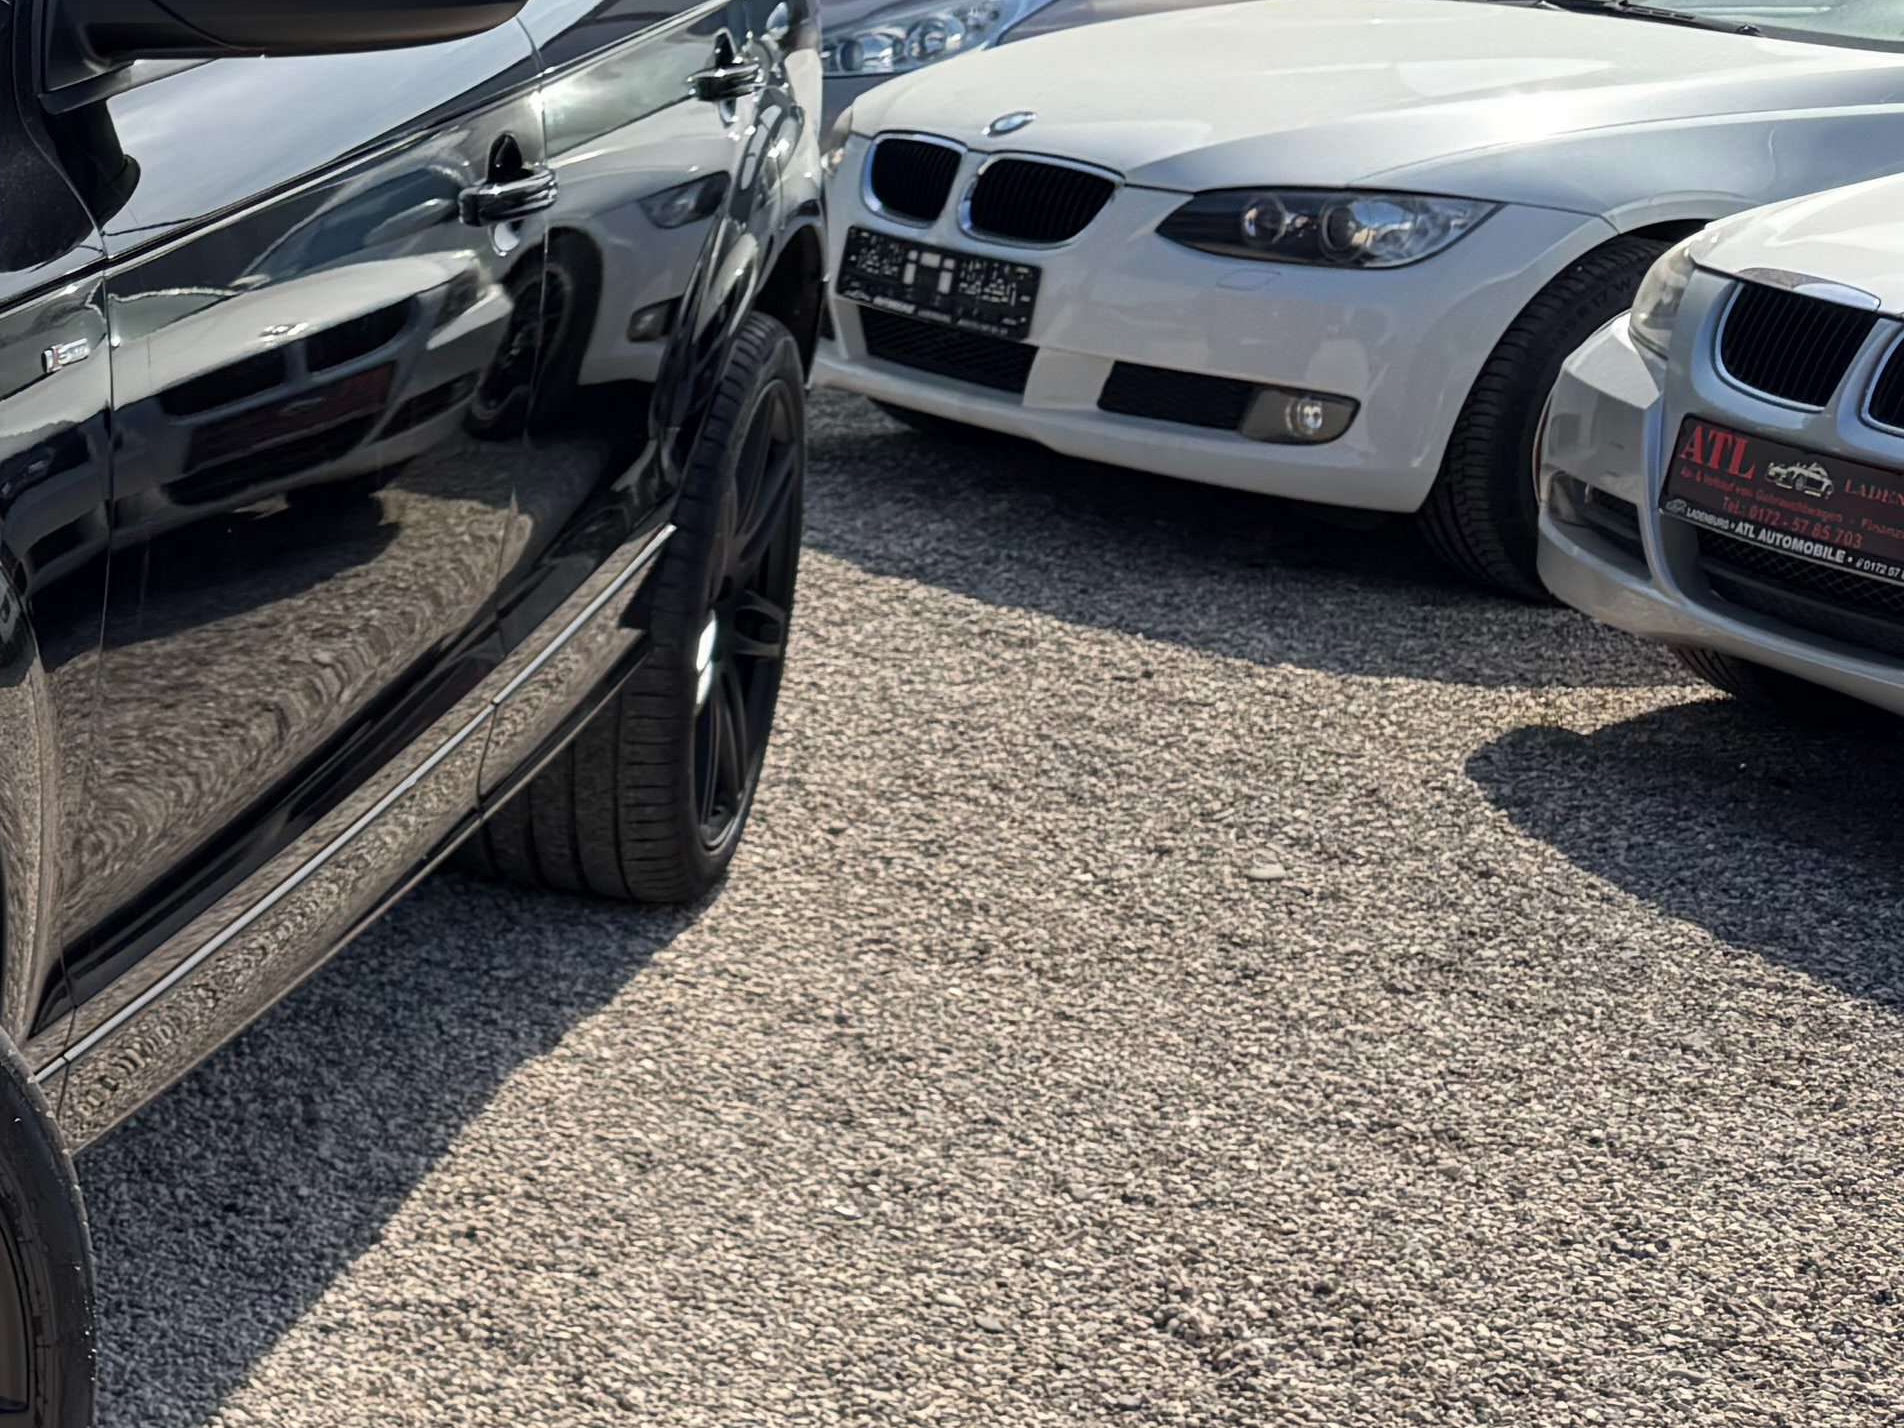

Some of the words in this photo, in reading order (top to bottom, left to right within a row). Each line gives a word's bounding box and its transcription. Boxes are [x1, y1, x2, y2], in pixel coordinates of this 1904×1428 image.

[1679, 425, 1756, 481] ATL
[1750, 506, 1782, 527] 0172
[1734, 521, 1757, 539] ATL
[1757, 528, 1847, 564] AUTOMOBILE
